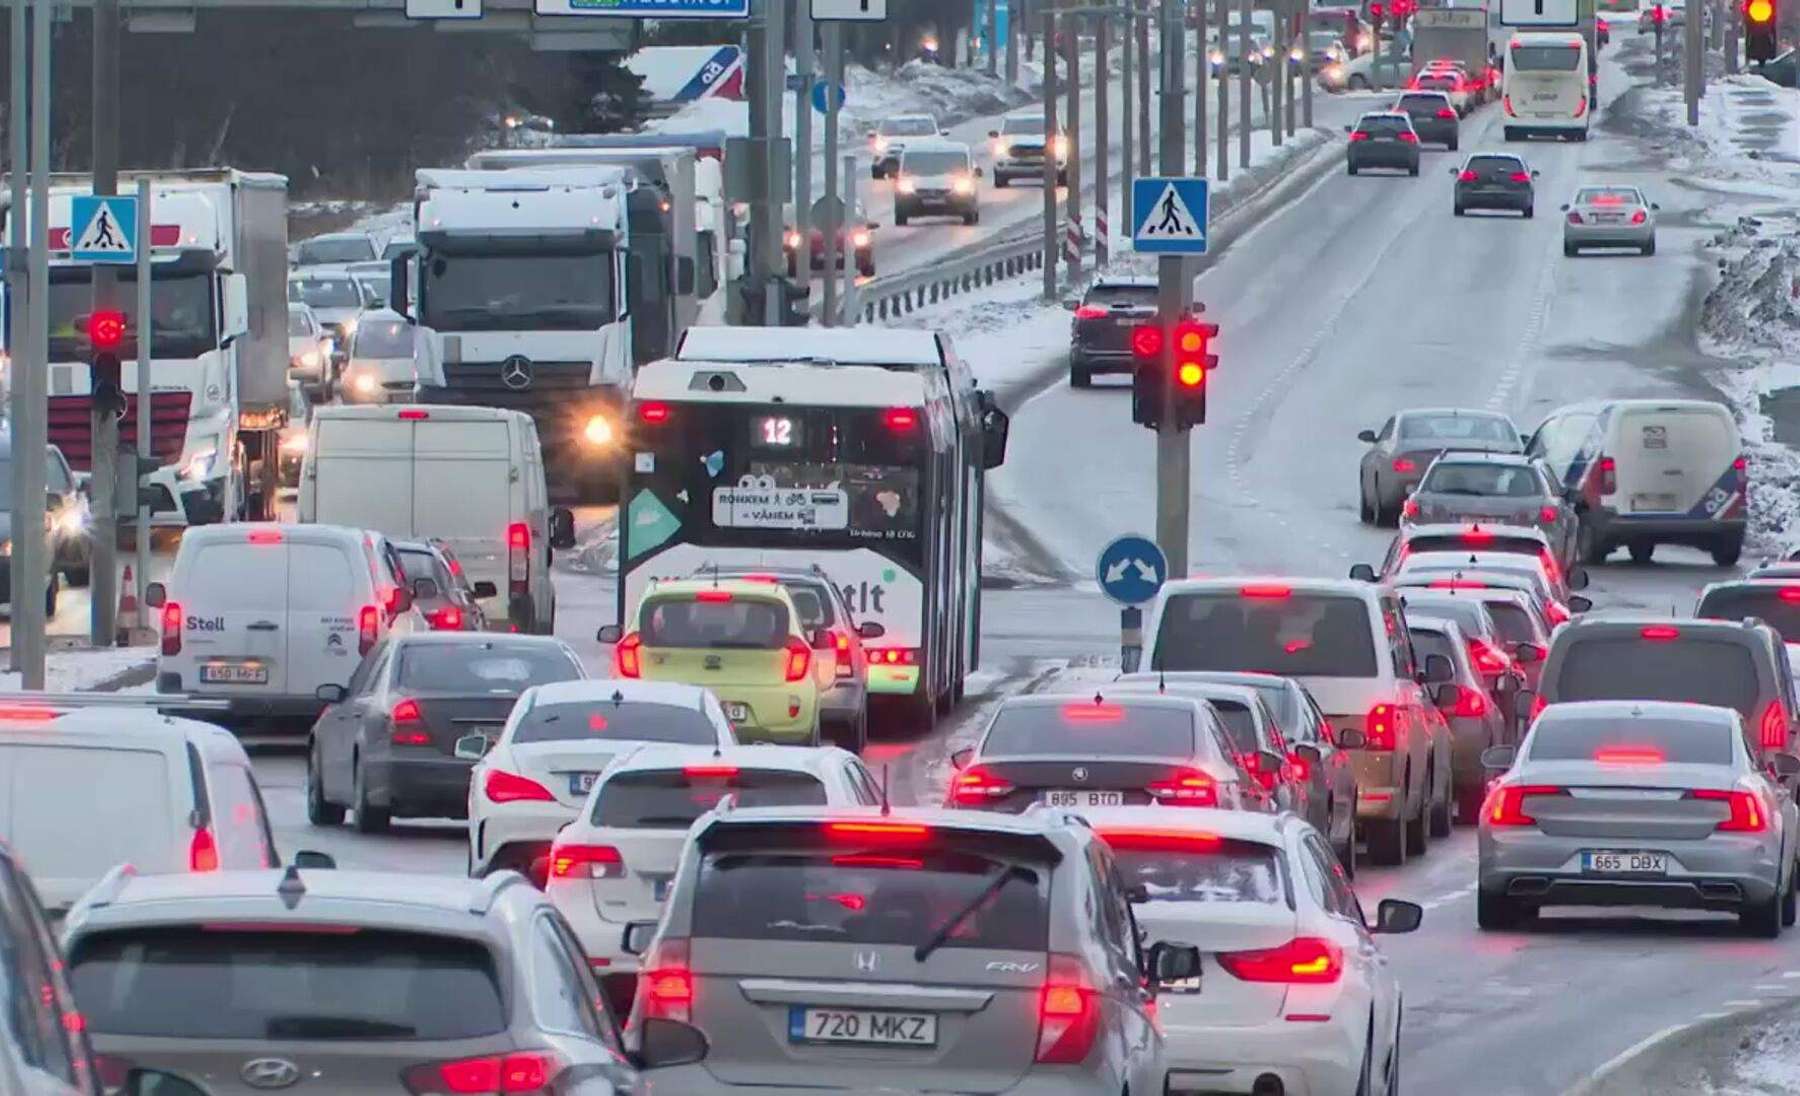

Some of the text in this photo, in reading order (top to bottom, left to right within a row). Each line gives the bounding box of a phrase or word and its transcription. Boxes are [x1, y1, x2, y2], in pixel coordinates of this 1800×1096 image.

[764, 418, 792, 444] 12
[842, 581, 885, 613] tlt
[186, 616, 225, 632] Stell
[1595, 855, 1661, 869] 665 DBX
[815, 1013, 926, 1040] 720 MKZ
